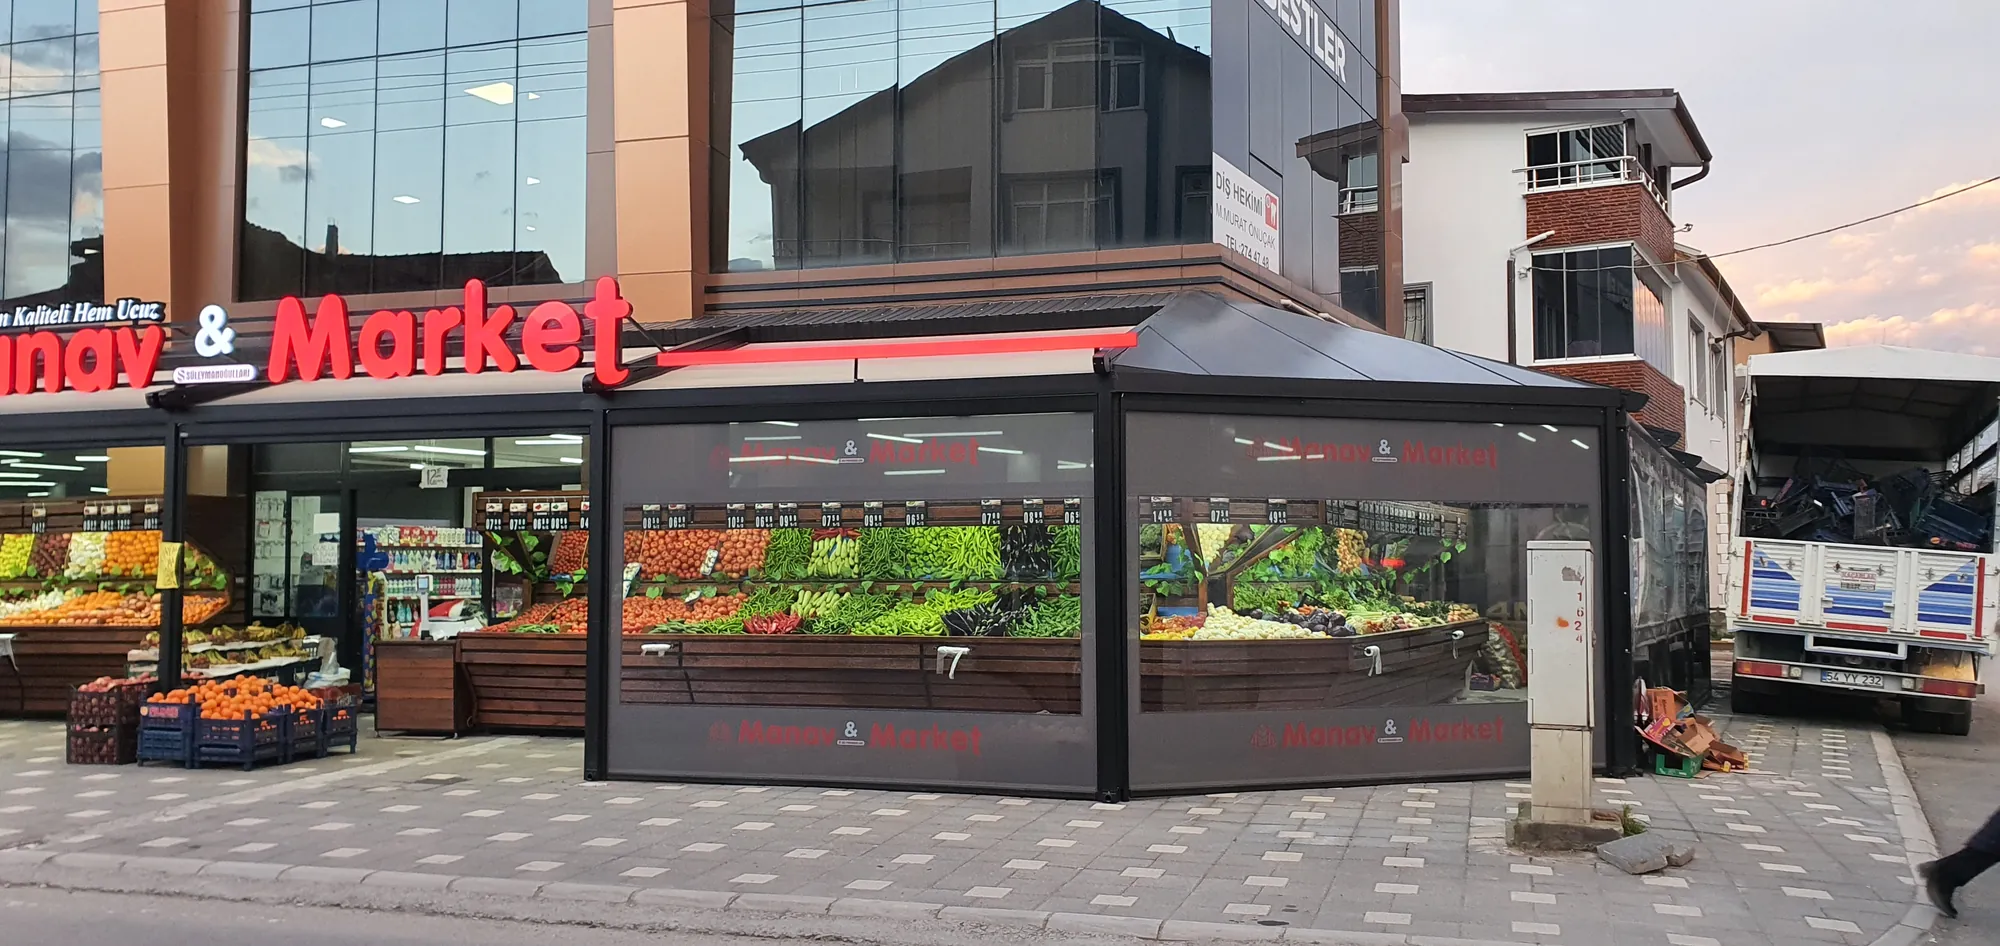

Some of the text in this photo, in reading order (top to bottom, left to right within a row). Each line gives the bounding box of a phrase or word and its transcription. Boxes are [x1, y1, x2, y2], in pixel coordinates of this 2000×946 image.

[1216, 171, 1263, 217] DİŞ HEKİMİ
[13, 302, 73, 327] Kaliteli
[73, 301, 114, 323] Hem
[116, 298, 161, 321] Ucuz
[194, 304, 236, 358] &
[268, 276, 633, 387] Market
[844, 439, 858, 456] &
[869, 437, 979, 468] Market
[1378, 438, 1391, 455] &
[1402, 440, 1497, 470] Market
[1826, 671, 1840, 681] 54
[1843, 673, 1859, 684] YY
[1862, 675, 1882, 686] 232
[738, 719, 982, 755] Manav & Market
[1282, 716, 1505, 748] Manav & Market
